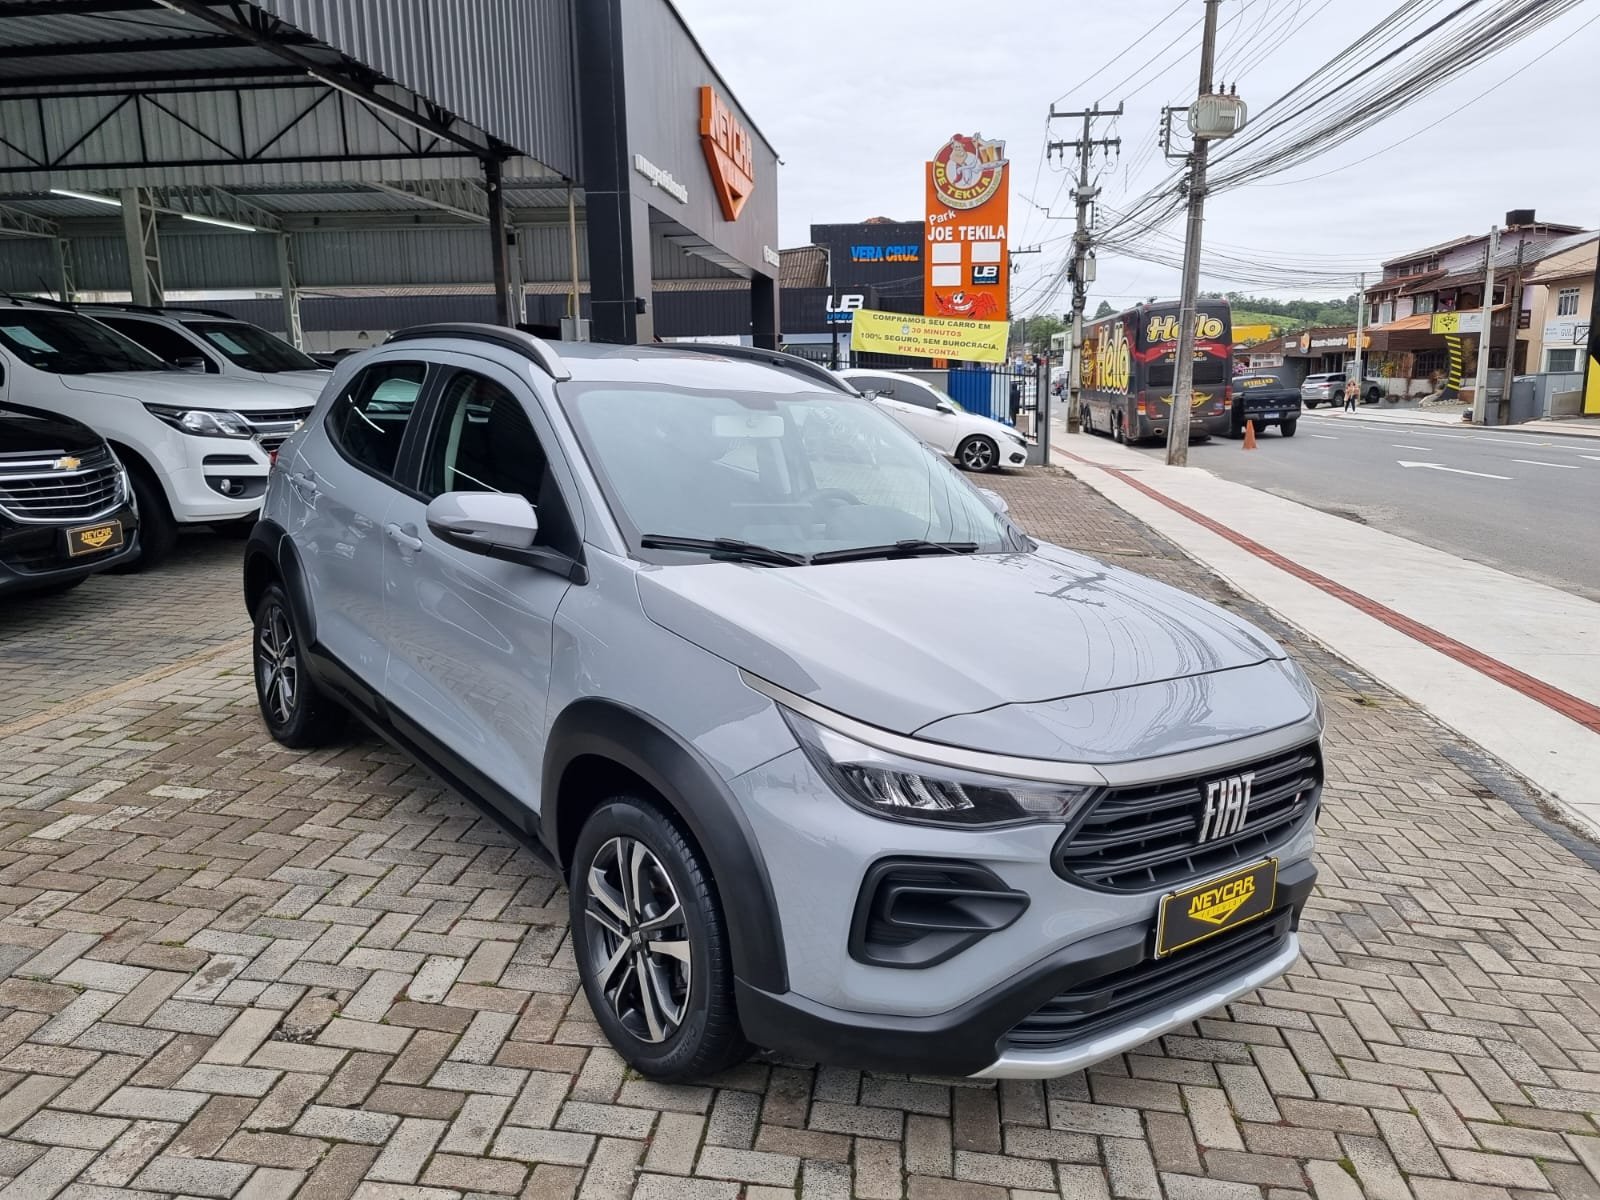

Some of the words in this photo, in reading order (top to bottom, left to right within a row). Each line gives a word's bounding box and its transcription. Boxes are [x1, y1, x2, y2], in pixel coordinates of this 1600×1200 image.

[710, 87, 752, 181] NEYCAR
[935, 161, 947, 186] JOE
[947, 177, 991, 199] TEKILA
[928, 209, 956, 226] Park
[928, 226, 953, 241] JOE
[958, 224, 1006, 241] TEKILA
[850, 246, 884, 262] VERA
[885, 245, 919, 262] CRUZ
[974, 266, 997, 278] UB
[826, 294, 865, 313] UB
[872, 313, 926, 325] COMPRAMOS
[928, 319, 945, 327] SEU
[947, 320, 976, 329] CARRO
[1146, 313, 1223, 343] Hlo
[861, 332, 882, 340] 100%
[884, 334, 921, 344] SEGURO,
[923, 337, 940, 345] SEM
[923, 328, 962, 337] MINUTOS
[898, 345, 912, 353] PIX
[928, 348, 959, 356] CONTA!
[1096, 321, 1130, 395] Hello
[81, 527, 113, 541] NEYCAR
[1198, 772, 1256, 843] FIAT
[1187, 875, 1256, 915] NEYCAR
